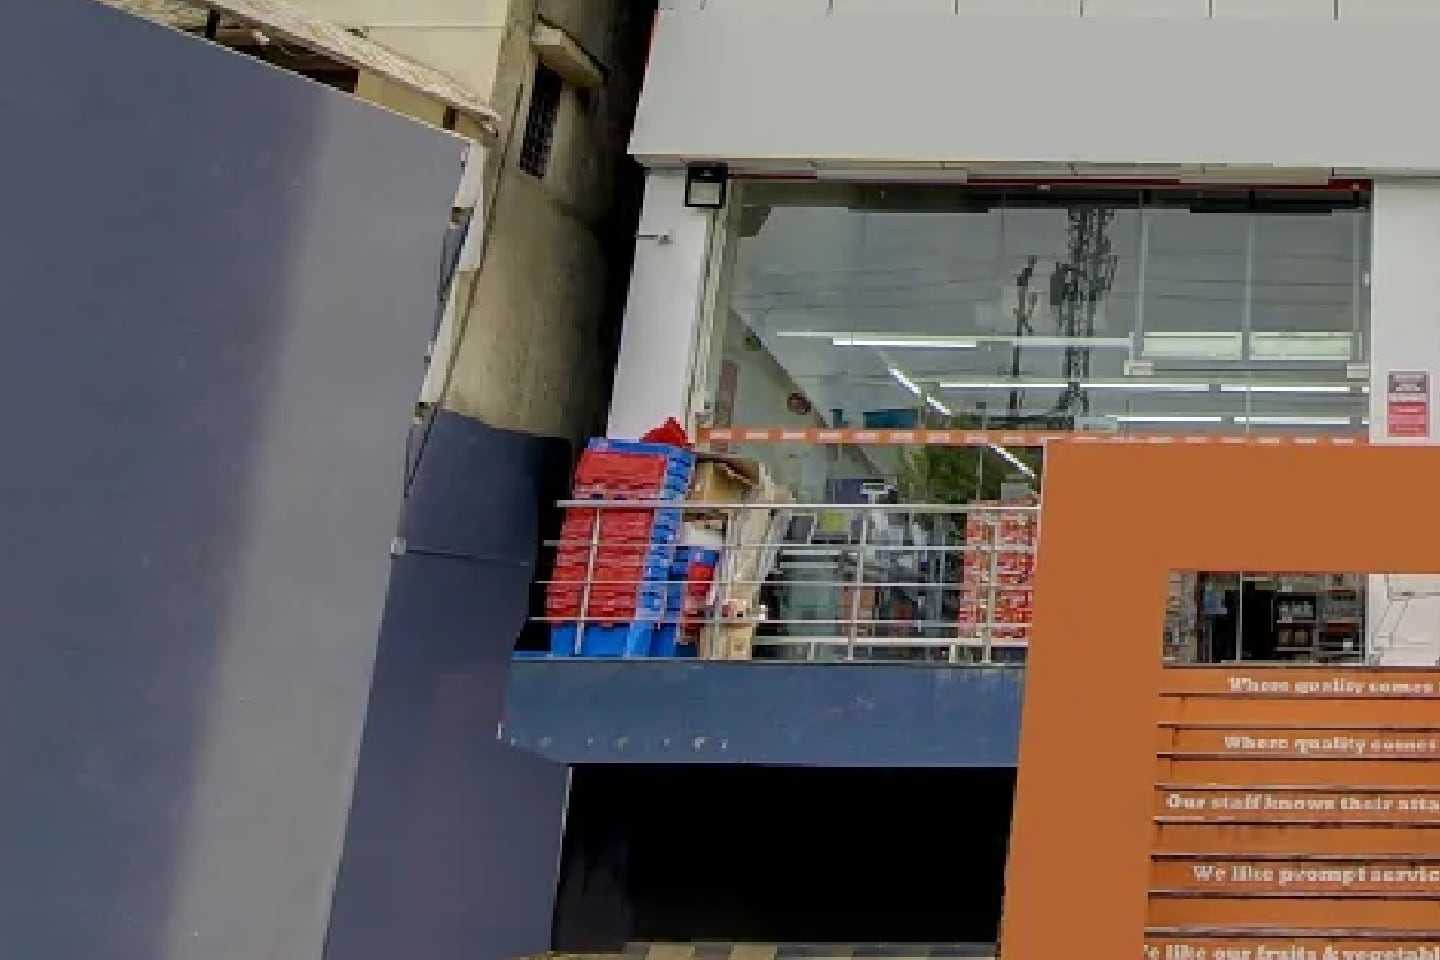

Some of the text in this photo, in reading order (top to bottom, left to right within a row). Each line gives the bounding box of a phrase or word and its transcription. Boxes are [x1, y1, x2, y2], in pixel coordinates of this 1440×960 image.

[1228, 677, 1289, 692] Where
[1294, 677, 1365, 694] quality
[1224, 736, 1289, 750] Where
[1294, 736, 1366, 753] quality
[1166, 793, 1207, 809] Our
[1211, 794, 1262, 809] staff
[1340, 796, 1392, 810] their
[1193, 865, 1227, 882] We
[1232, 865, 1274, 882] like
[1278, 867, 1367, 887] prompt
